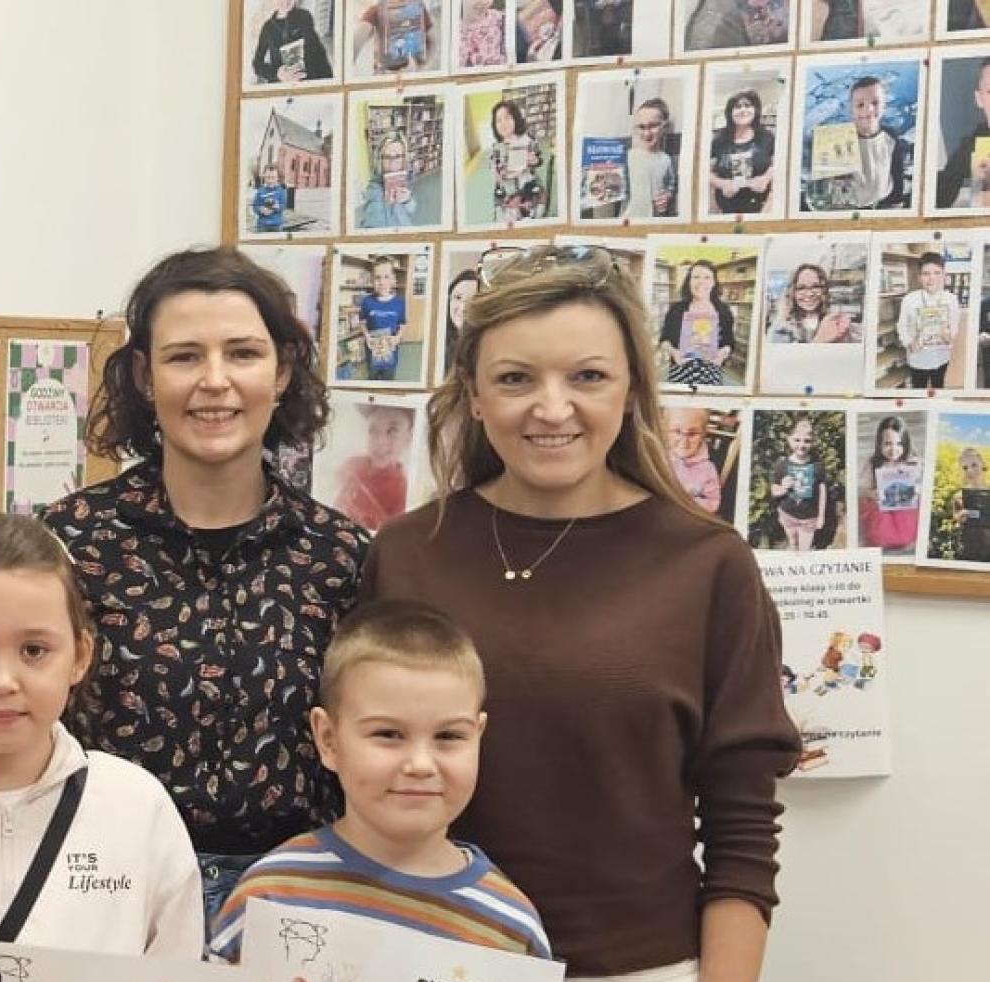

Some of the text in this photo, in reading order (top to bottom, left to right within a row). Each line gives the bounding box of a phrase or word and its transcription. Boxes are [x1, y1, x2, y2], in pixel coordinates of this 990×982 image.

[30, 387, 65, 398] GODZINY
[26, 400, 68, 411] OTWARCIA
[764, 562, 872, 577] WA NA CZYTANIE
[67, 864, 98, 872] YOUR
[68, 874, 132, 895] Lifestyle
